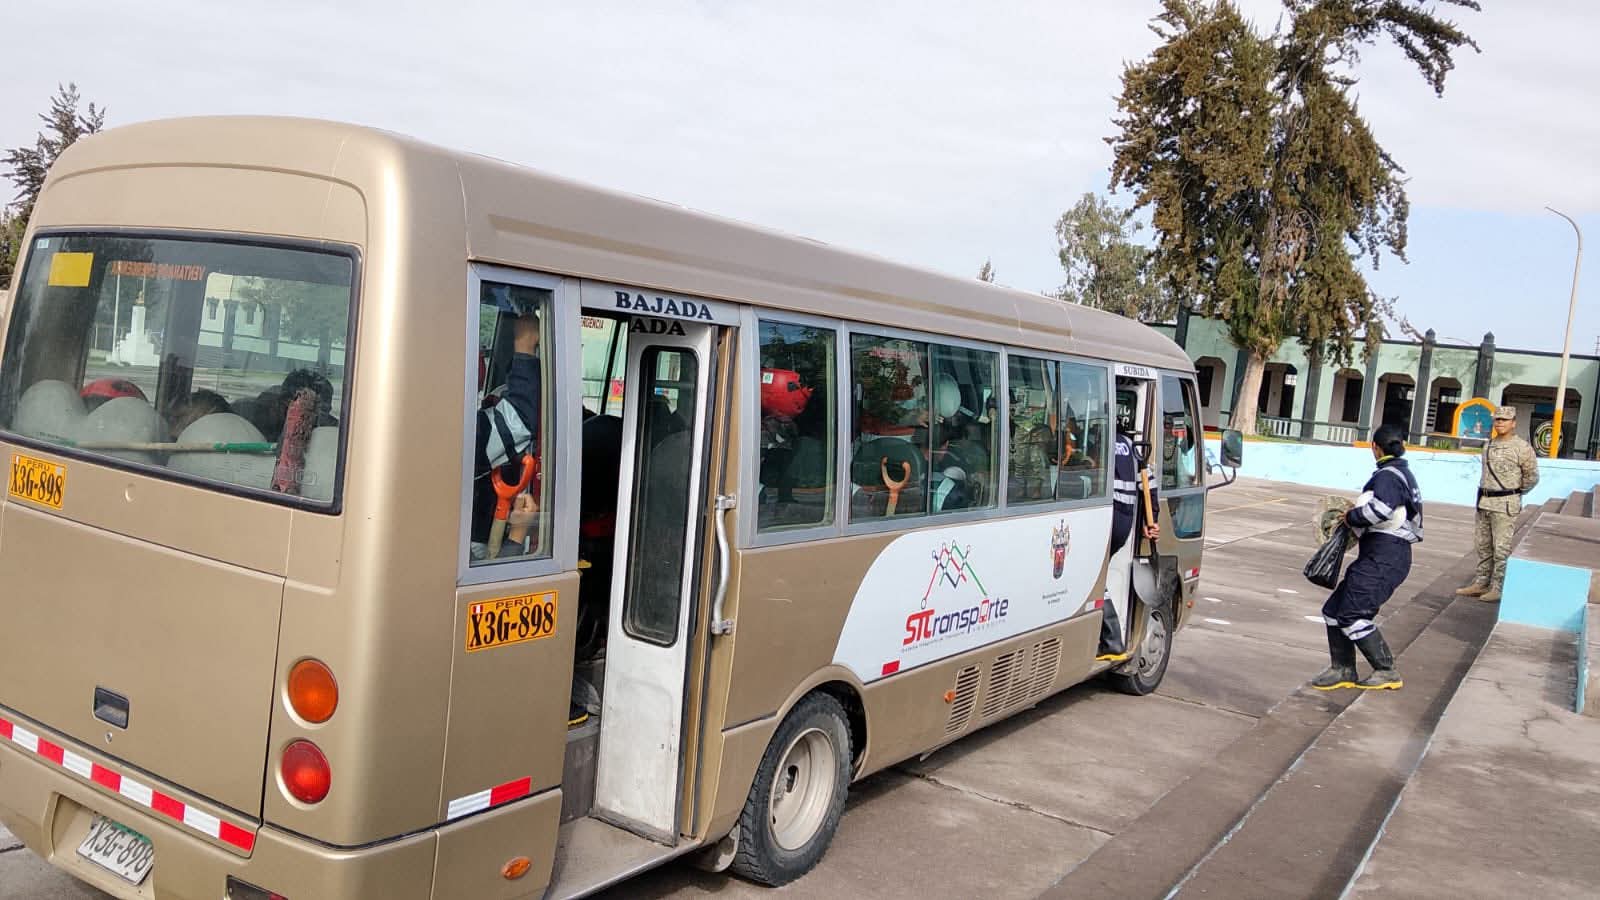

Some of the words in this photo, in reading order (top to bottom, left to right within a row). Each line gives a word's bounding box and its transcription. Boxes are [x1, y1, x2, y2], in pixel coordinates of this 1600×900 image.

[615, 290, 713, 321] BAJADA
[1123, 365, 1150, 377] SUBIDA
[10, 463, 63, 505] X3G-898
[495, 597, 533, 610] PERU
[469, 602, 554, 647] X3G-898
[84, 820, 154, 873] X3G-898
